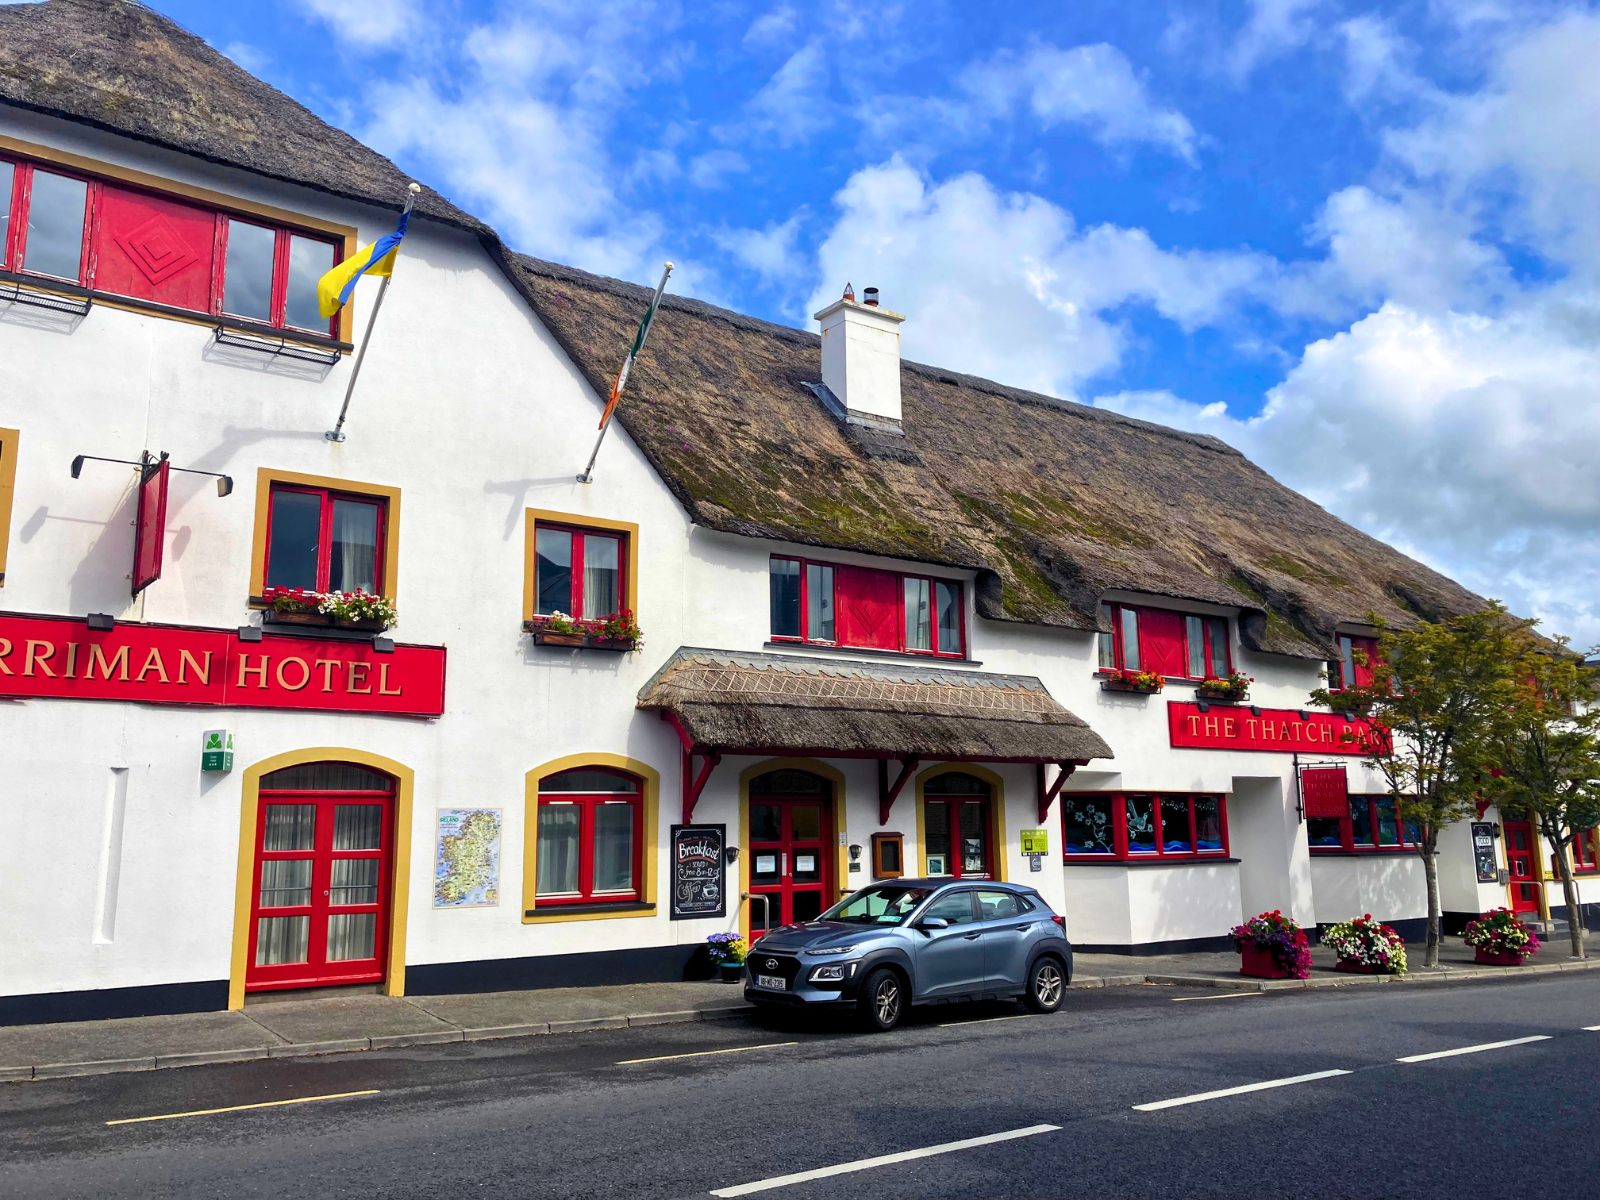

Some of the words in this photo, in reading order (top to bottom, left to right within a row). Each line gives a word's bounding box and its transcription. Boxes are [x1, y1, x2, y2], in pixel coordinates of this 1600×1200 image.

[236, 653, 402, 696] HOTEL
[1187, 715, 1237, 738] THE
[1246, 719, 1334, 743] THATCH
[1342, 724, 1380, 745] BAR
[1305, 782, 1344, 790] THATCH
[678, 840, 720, 860] Breakfast
[676, 881, 701, 905] Coffee
